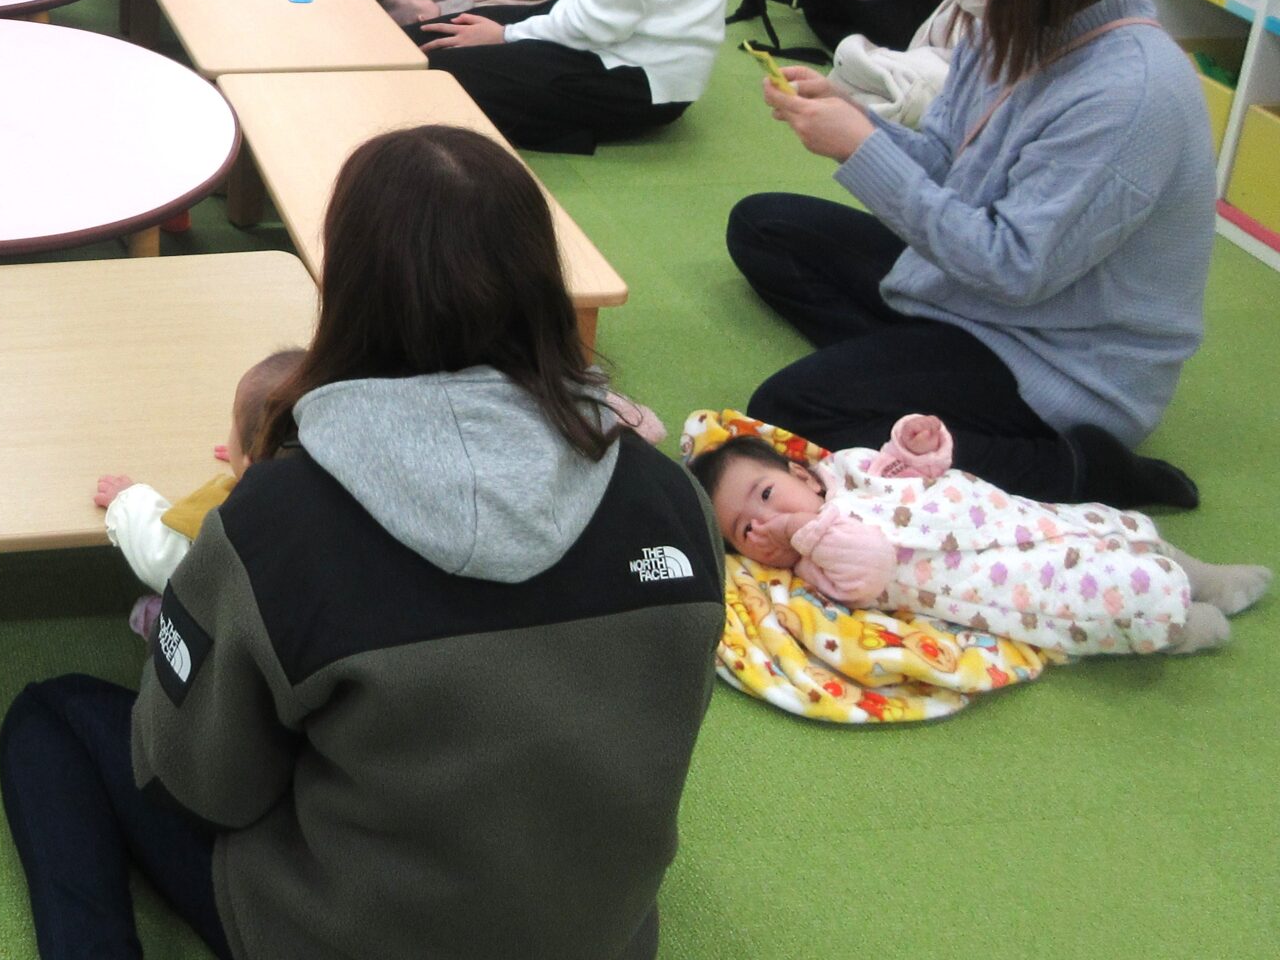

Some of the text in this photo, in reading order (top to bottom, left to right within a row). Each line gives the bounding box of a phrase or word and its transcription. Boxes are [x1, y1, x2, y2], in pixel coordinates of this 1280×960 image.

[641, 546, 665, 559] THE
[629, 558, 666, 572] NORTH
[639, 569, 669, 582] FACE
